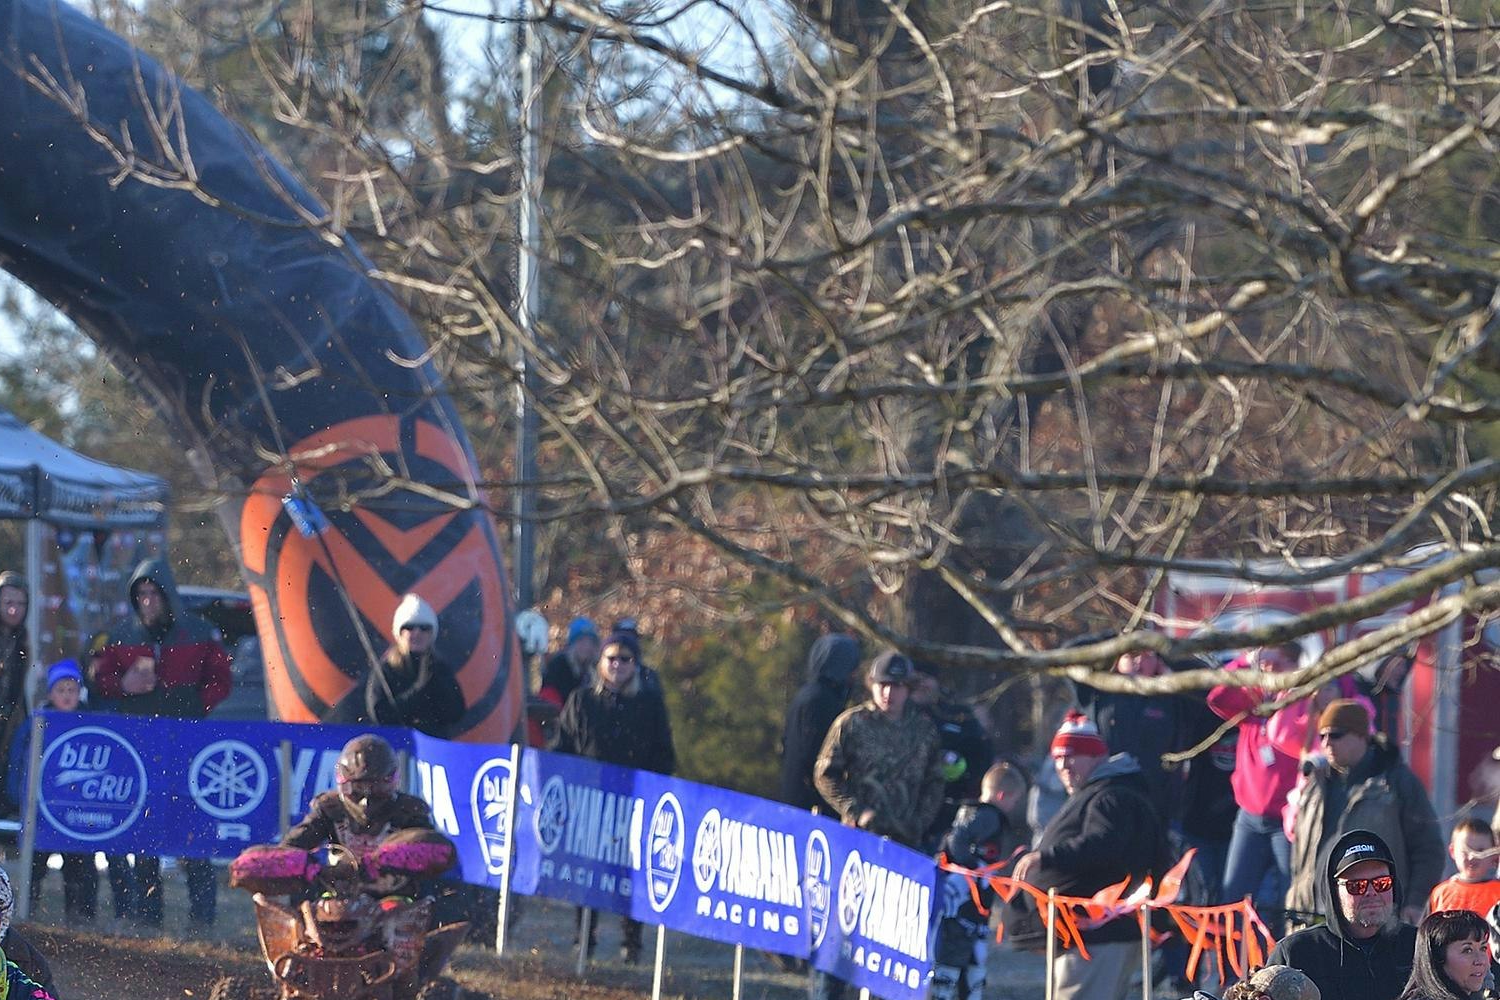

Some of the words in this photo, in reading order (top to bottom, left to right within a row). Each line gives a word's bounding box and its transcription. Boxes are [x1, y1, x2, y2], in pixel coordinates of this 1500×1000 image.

[565, 783, 645, 871] YAMAHA
[541, 860, 633, 897] RACING
[719, 817, 803, 909] YAMAHA
[696, 896, 799, 936] RACING
[841, 941, 921, 990] RACING
